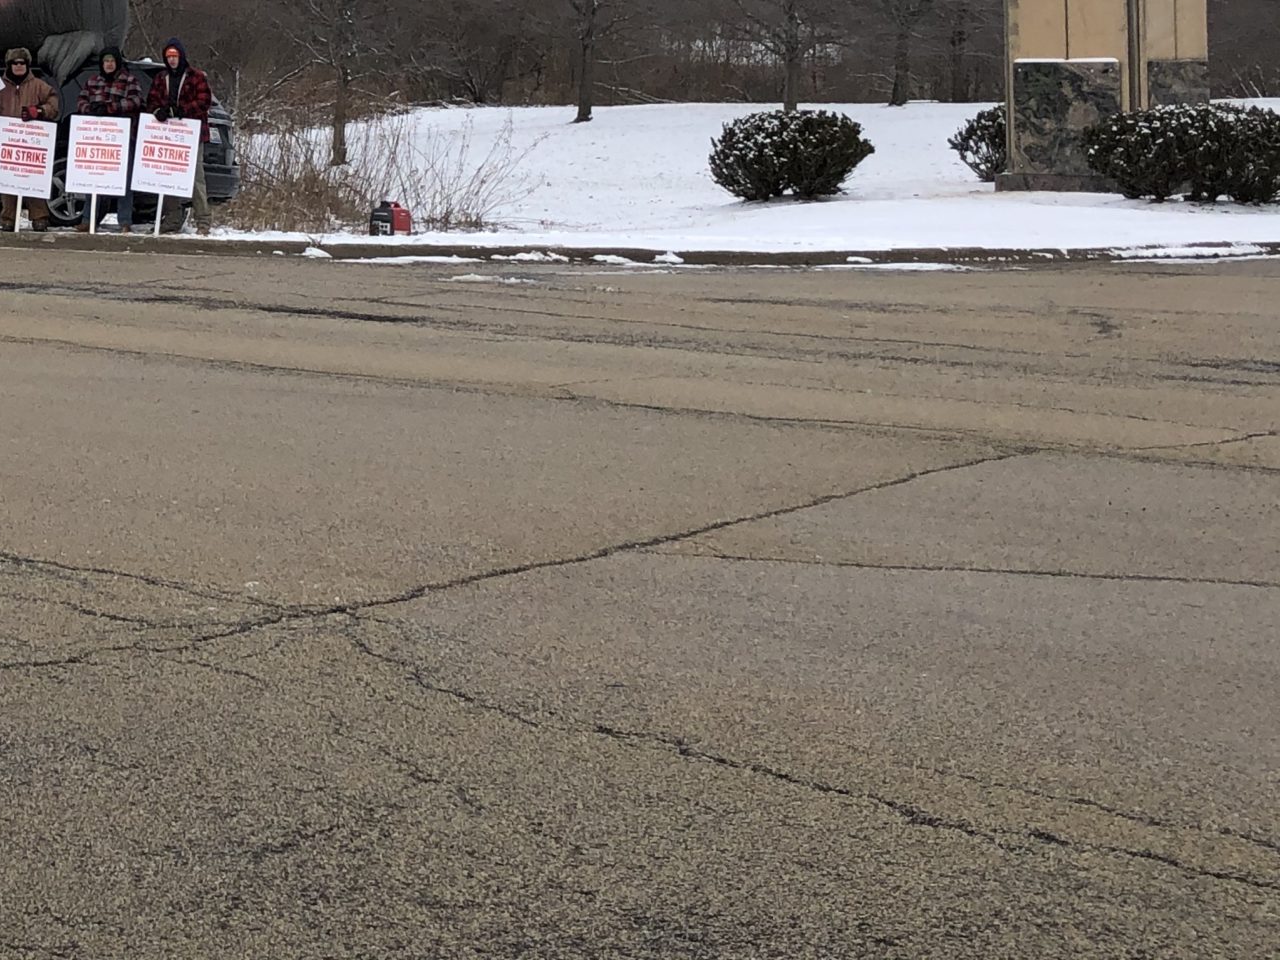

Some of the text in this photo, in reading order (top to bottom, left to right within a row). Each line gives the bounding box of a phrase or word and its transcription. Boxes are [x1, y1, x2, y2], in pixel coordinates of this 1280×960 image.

[0, 148, 46, 163] ON STRIKE
[75, 147, 120, 160] ON STRIKE
[142, 145, 189, 161] ON STRIKE
